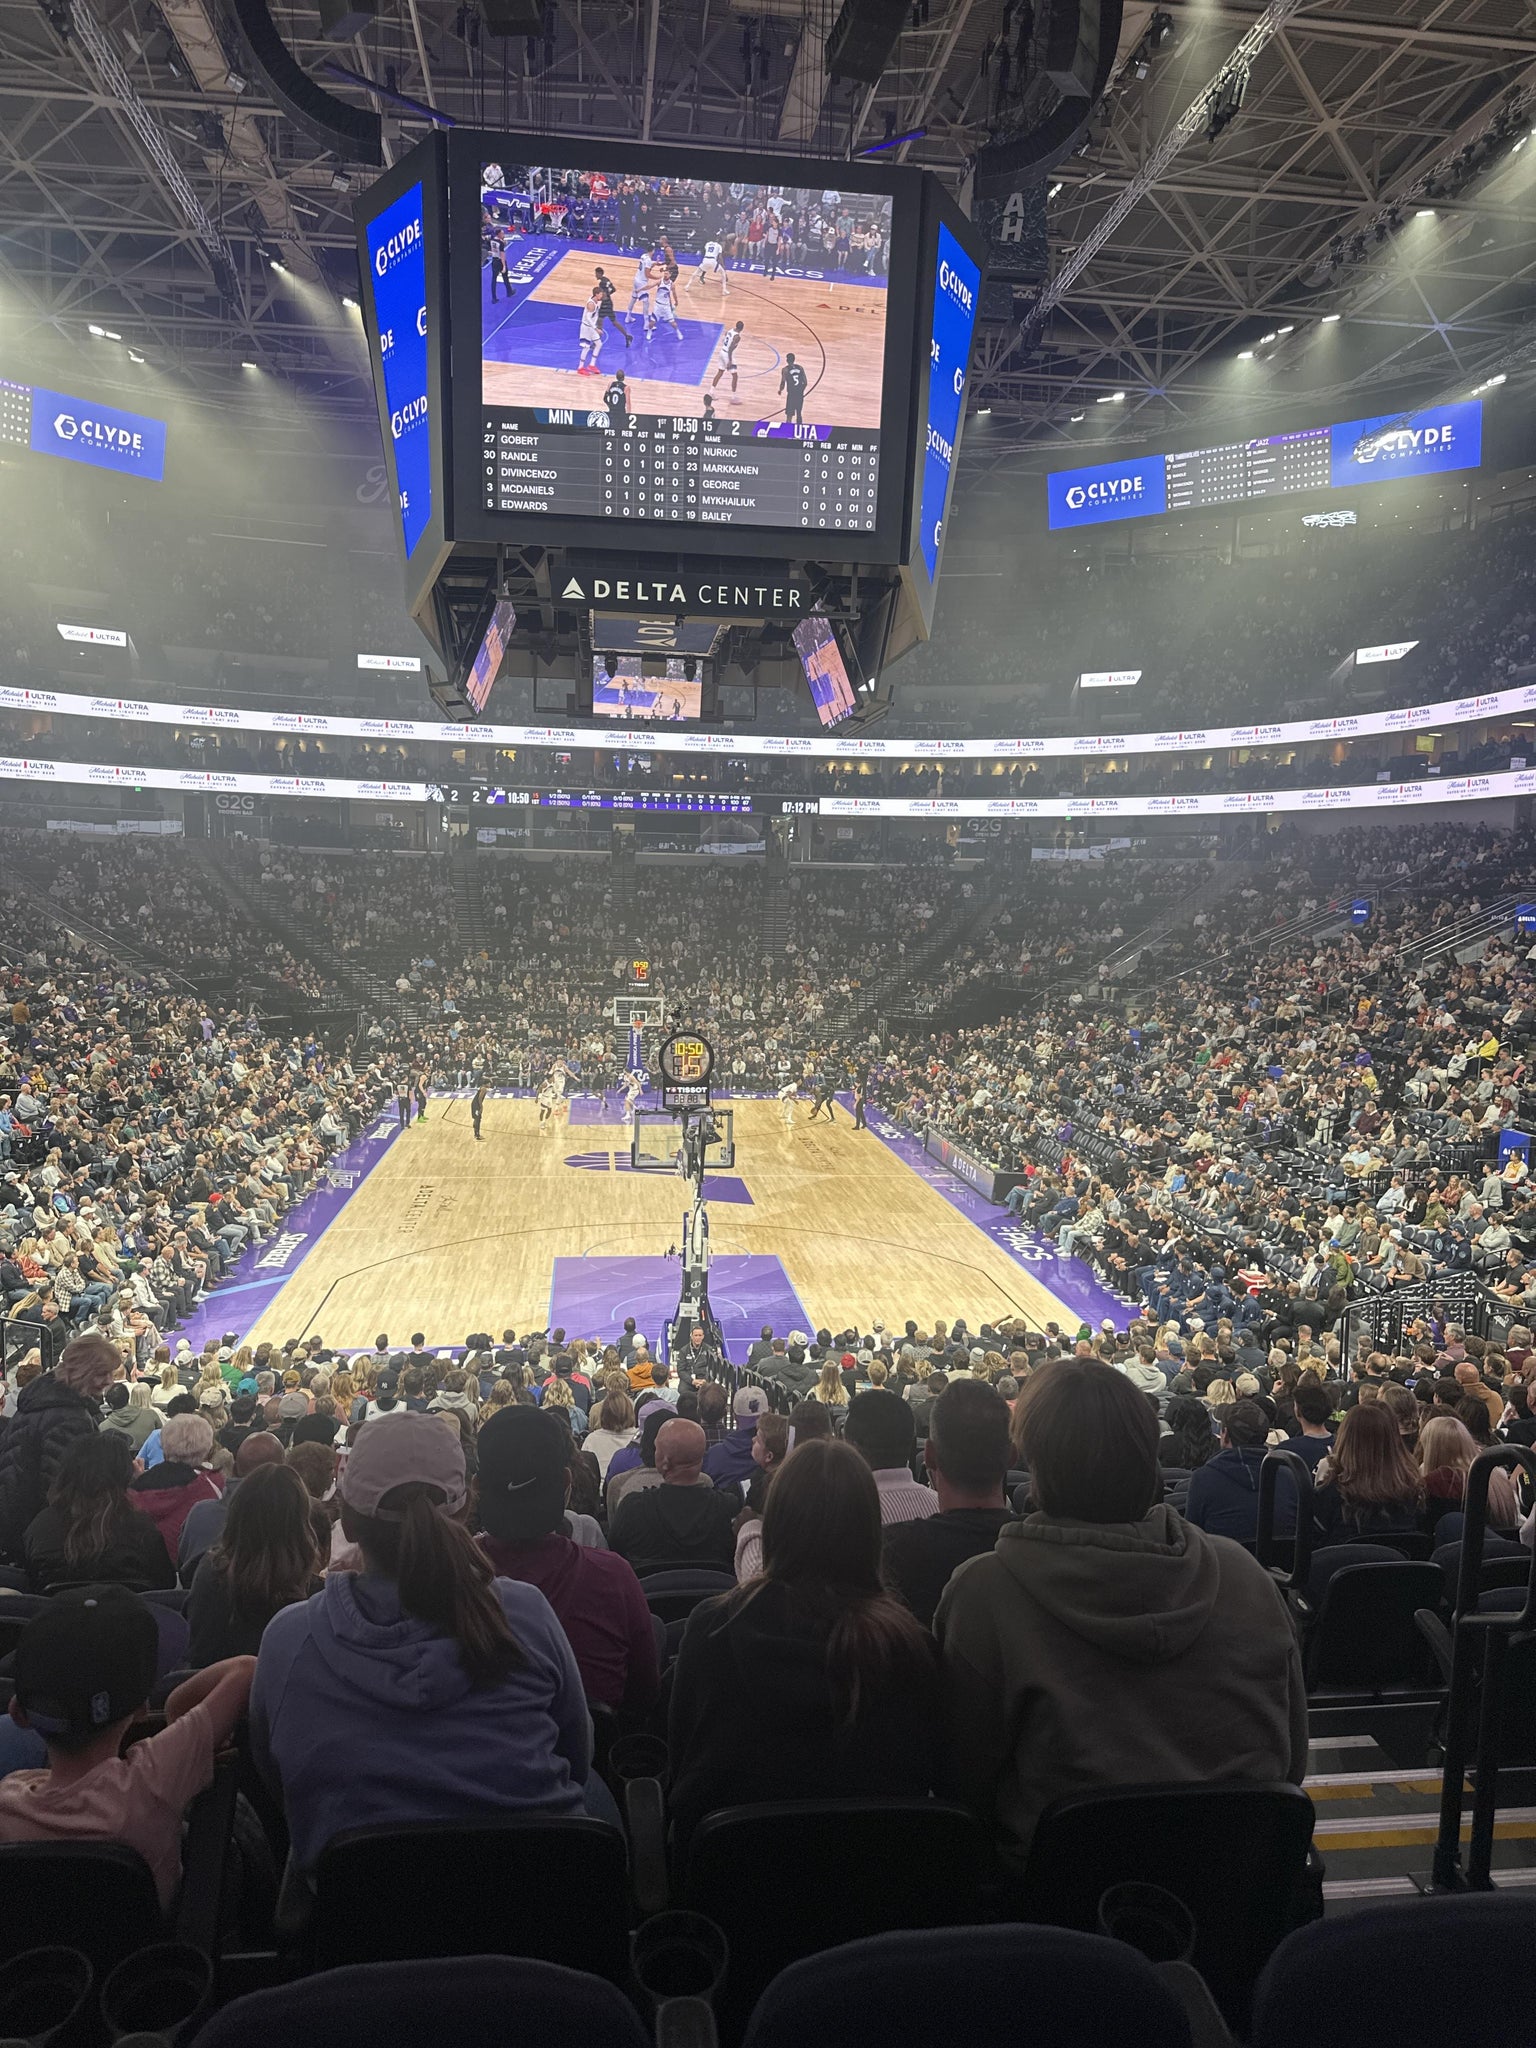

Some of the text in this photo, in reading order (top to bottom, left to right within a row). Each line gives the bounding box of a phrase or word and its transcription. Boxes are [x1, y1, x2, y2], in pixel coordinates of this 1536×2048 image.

[387, 219, 421, 256] CLYDE
[513, 248, 548, 271] HEALTH
[949, 271, 973, 309] CLYDE
[793, 374, 799, 386] 5
[612, 394, 618, 404] 0
[549, 409, 817, 439] MIN 2 1ST 10:50 15 2 UTA
[80, 420, 142, 449] CLYDE
[80, 438, 141, 457] COMPANIES
[484, 434, 679, 454] 27 GOBERT 2 0 0 01 0
[931, 429, 952, 462] CLYDE
[1382, 444, 1452, 461] COMPANIES
[484, 450, 679, 470] 30 RANDLE 0 0 1 01 0
[687, 447, 698, 455] 30
[704, 449, 737, 457] NURKIC
[804, 454, 811, 462] 0
[822, 455, 828, 463] 0
[838, 455, 844, 463] 0
[869, 457, 875, 465] 0
[487, 467, 678, 486] 0 DIVINCENZO 0 0 0 01 0
[687, 463, 697, 471] 23
[703, 465, 758, 475] MARKKANEN
[804, 470, 810, 478] 2
[487, 483, 678, 502] 3 MCDANIELS 0 1 0 01 0
[689, 479, 694, 487] 3
[703, 480, 740, 490] GEORGE
[803, 486, 809, 494] 0
[822, 487, 826, 495] 1
[868, 489, 874, 497] 0
[1088, 476, 1143, 499] CLYDE
[687, 495, 696, 503] 10
[702, 496, 755, 507] MYKHAILIUK
[802, 502, 808, 510] 0
[820, 503, 826, 511] 0
[867, 505, 873, 513] 0
[1089, 493, 1143, 506] COMPANIES
[487, 500, 493, 508] 5
[502, 500, 547, 511] EDWARDS
[605, 506, 611, 514] 0
[639, 508, 645, 516] 0
[654, 509, 663, 517] 01
[672, 510, 678, 518] 0
[687, 511, 696, 519] 19
[702, 512, 732, 521] BAILEY
[835, 519, 841, 527] 0
[849, 520, 858, 528] 01
[593, 580, 800, 607] DELTA CENTER
[31, 693, 56, 701] ULTRA
[1480, 697, 1498, 706] ULTRA
[1412, 709, 1430, 717] ULTRA
[30, 762, 55, 770] ULTRA
[212, 774, 236, 782] ULTRA
[1471, 779, 1489, 787] ULTRA
[216, 794, 254, 809] G2G
[451, 790, 458, 801] 2
[473, 791, 480, 802] 2
[508, 793, 529, 804] 10:50
[782, 802, 818, 813] 07:12 PM
[967, 818, 1001, 831] G2G
[676, 1043, 703, 1054] 10:50
[682, 1056, 700, 1076] 15
[958, 1158, 976, 1182] DELTA
[253, 1233, 308, 1268] SEATGEEK
[997, 1233, 1053, 1260] PACS
